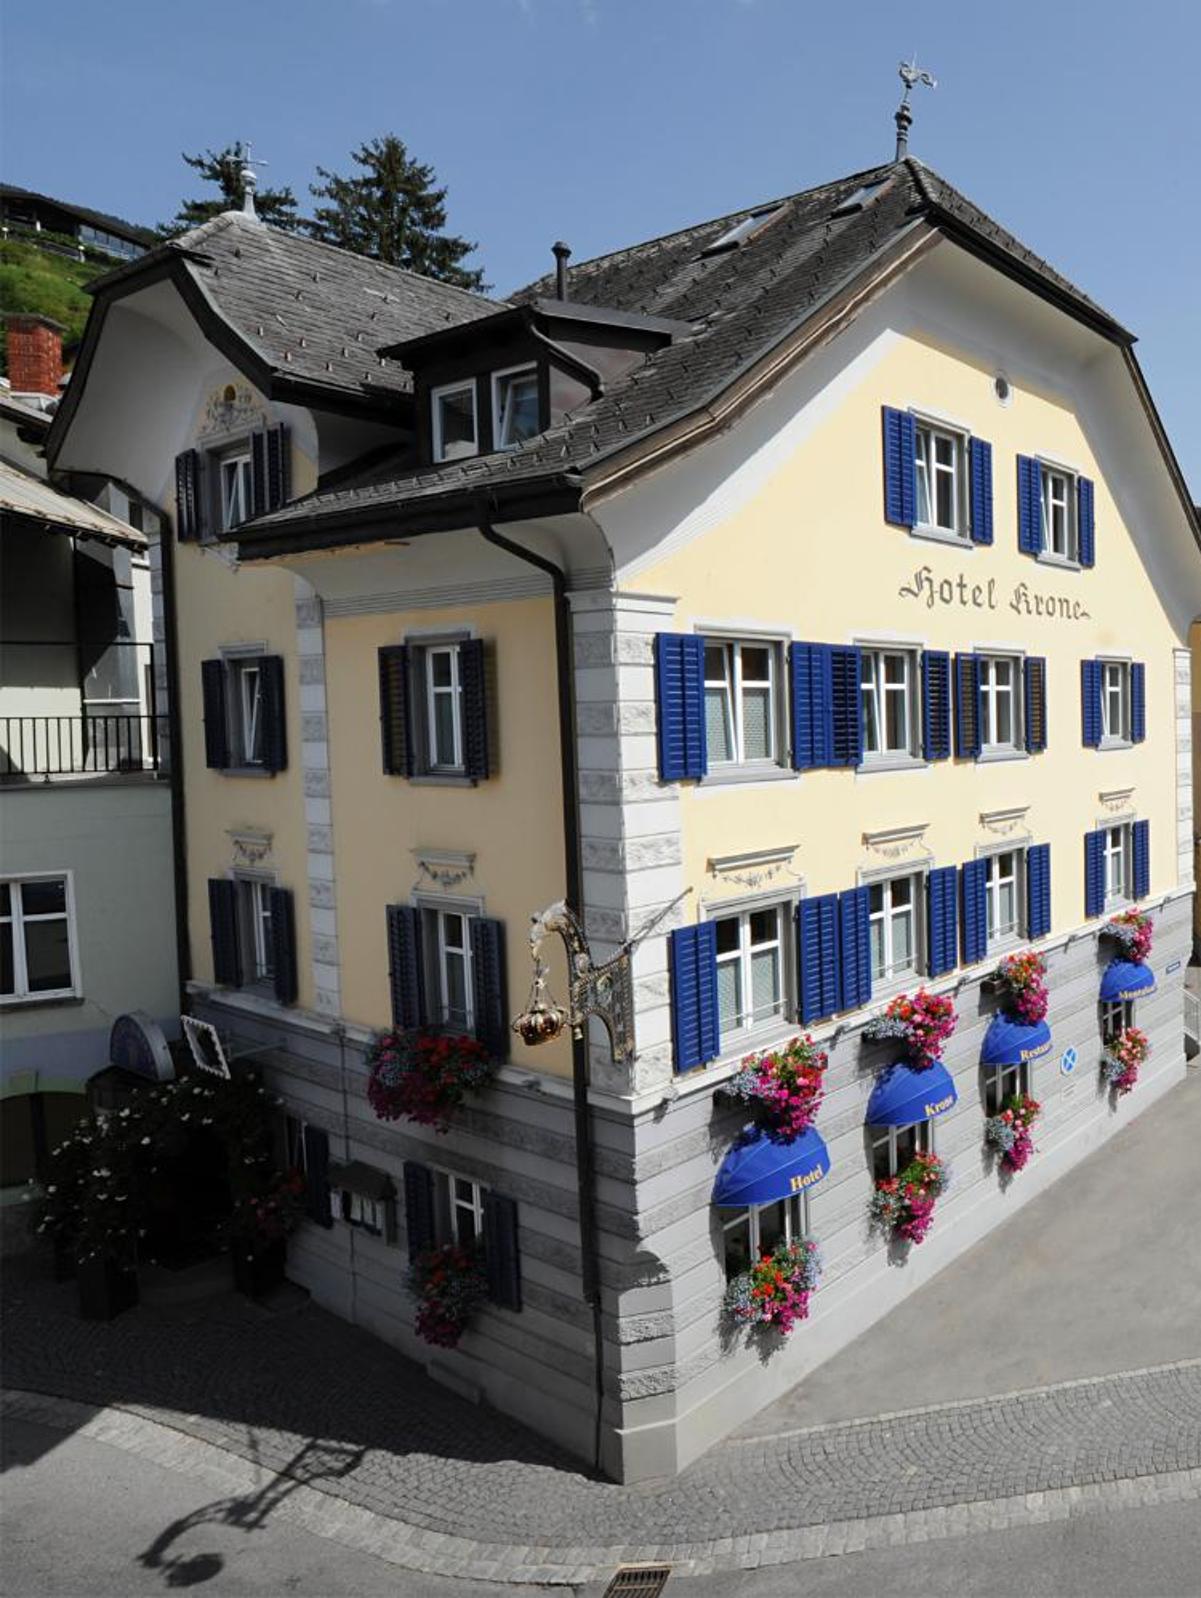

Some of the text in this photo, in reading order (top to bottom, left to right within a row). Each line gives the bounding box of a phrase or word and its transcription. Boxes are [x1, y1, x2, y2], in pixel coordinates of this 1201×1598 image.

[898, 566, 1092, 620] Hotel Krone
[924, 1094, 954, 1117] Krone
[790, 1163, 823, 1192] Hotel
